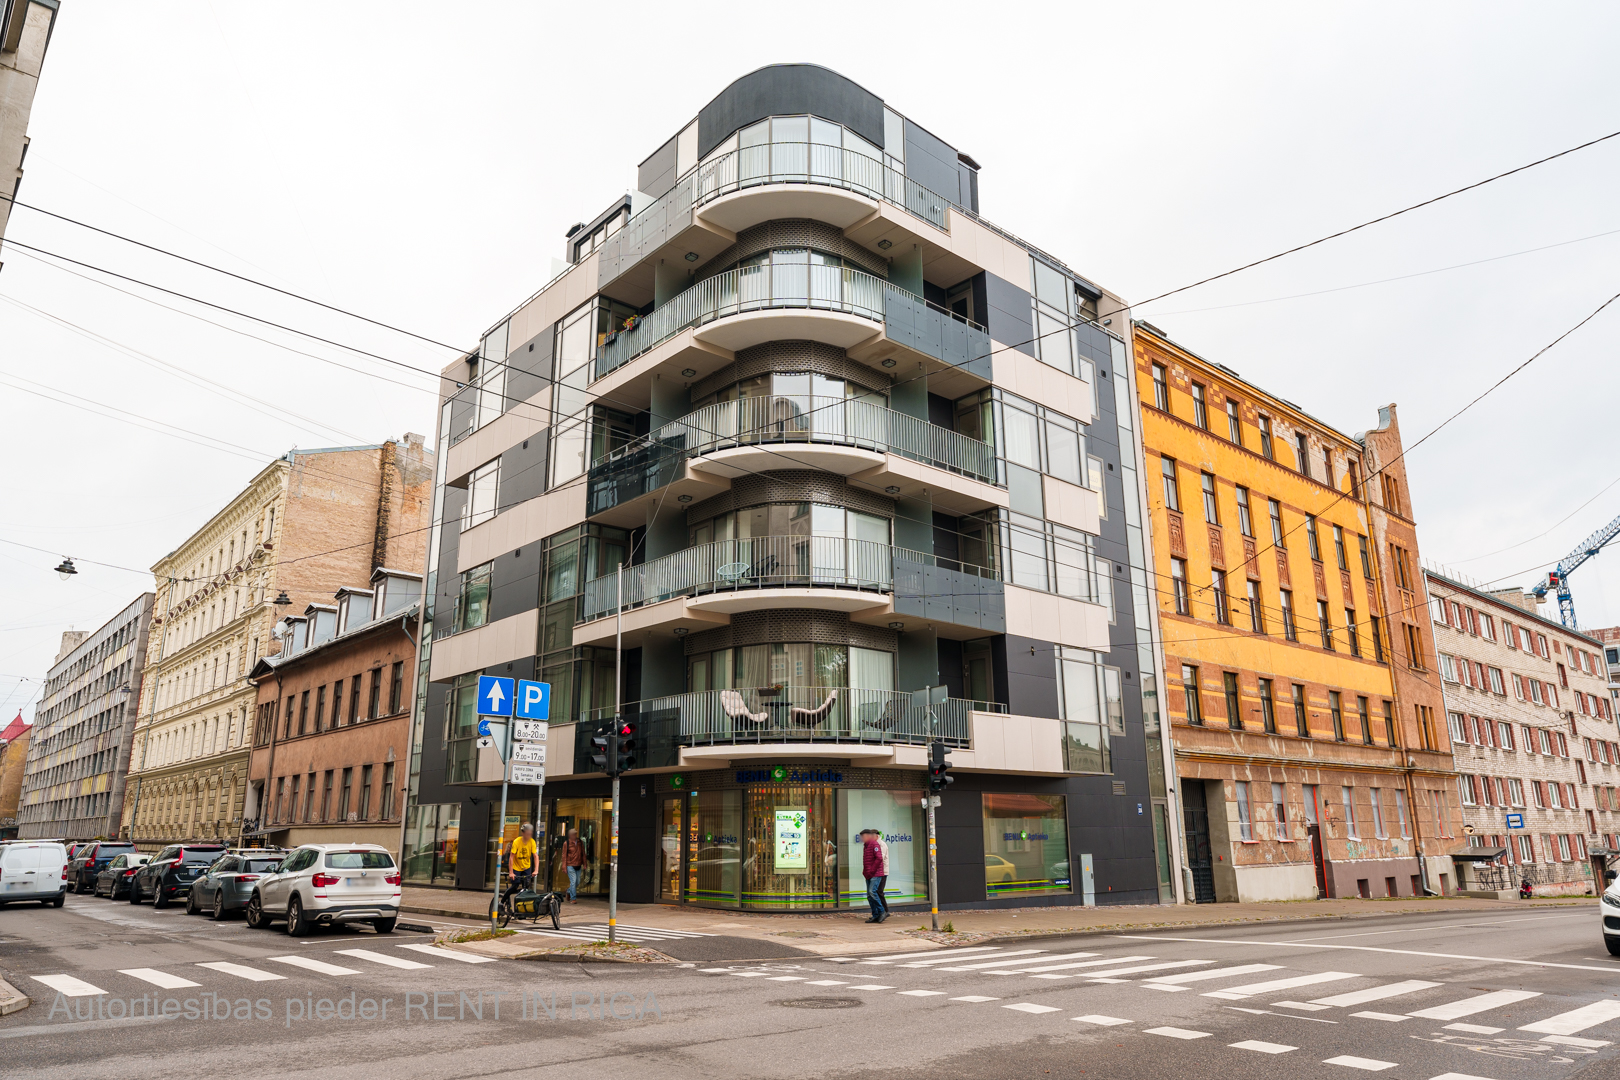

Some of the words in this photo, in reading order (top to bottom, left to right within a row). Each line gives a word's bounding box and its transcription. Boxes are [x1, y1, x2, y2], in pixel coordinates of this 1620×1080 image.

[524, 685, 543, 713] P
[736, 770, 771, 783] BENU
[790, 769, 843, 784] Aptieka
[689, 834, 706, 843] BENU
[713, 834, 738, 844] Aptieka
[885, 832, 913, 844] Aptieka
[1004, 832, 1021, 841] BENU
[1027, 832, 1049, 841] Aptieka
